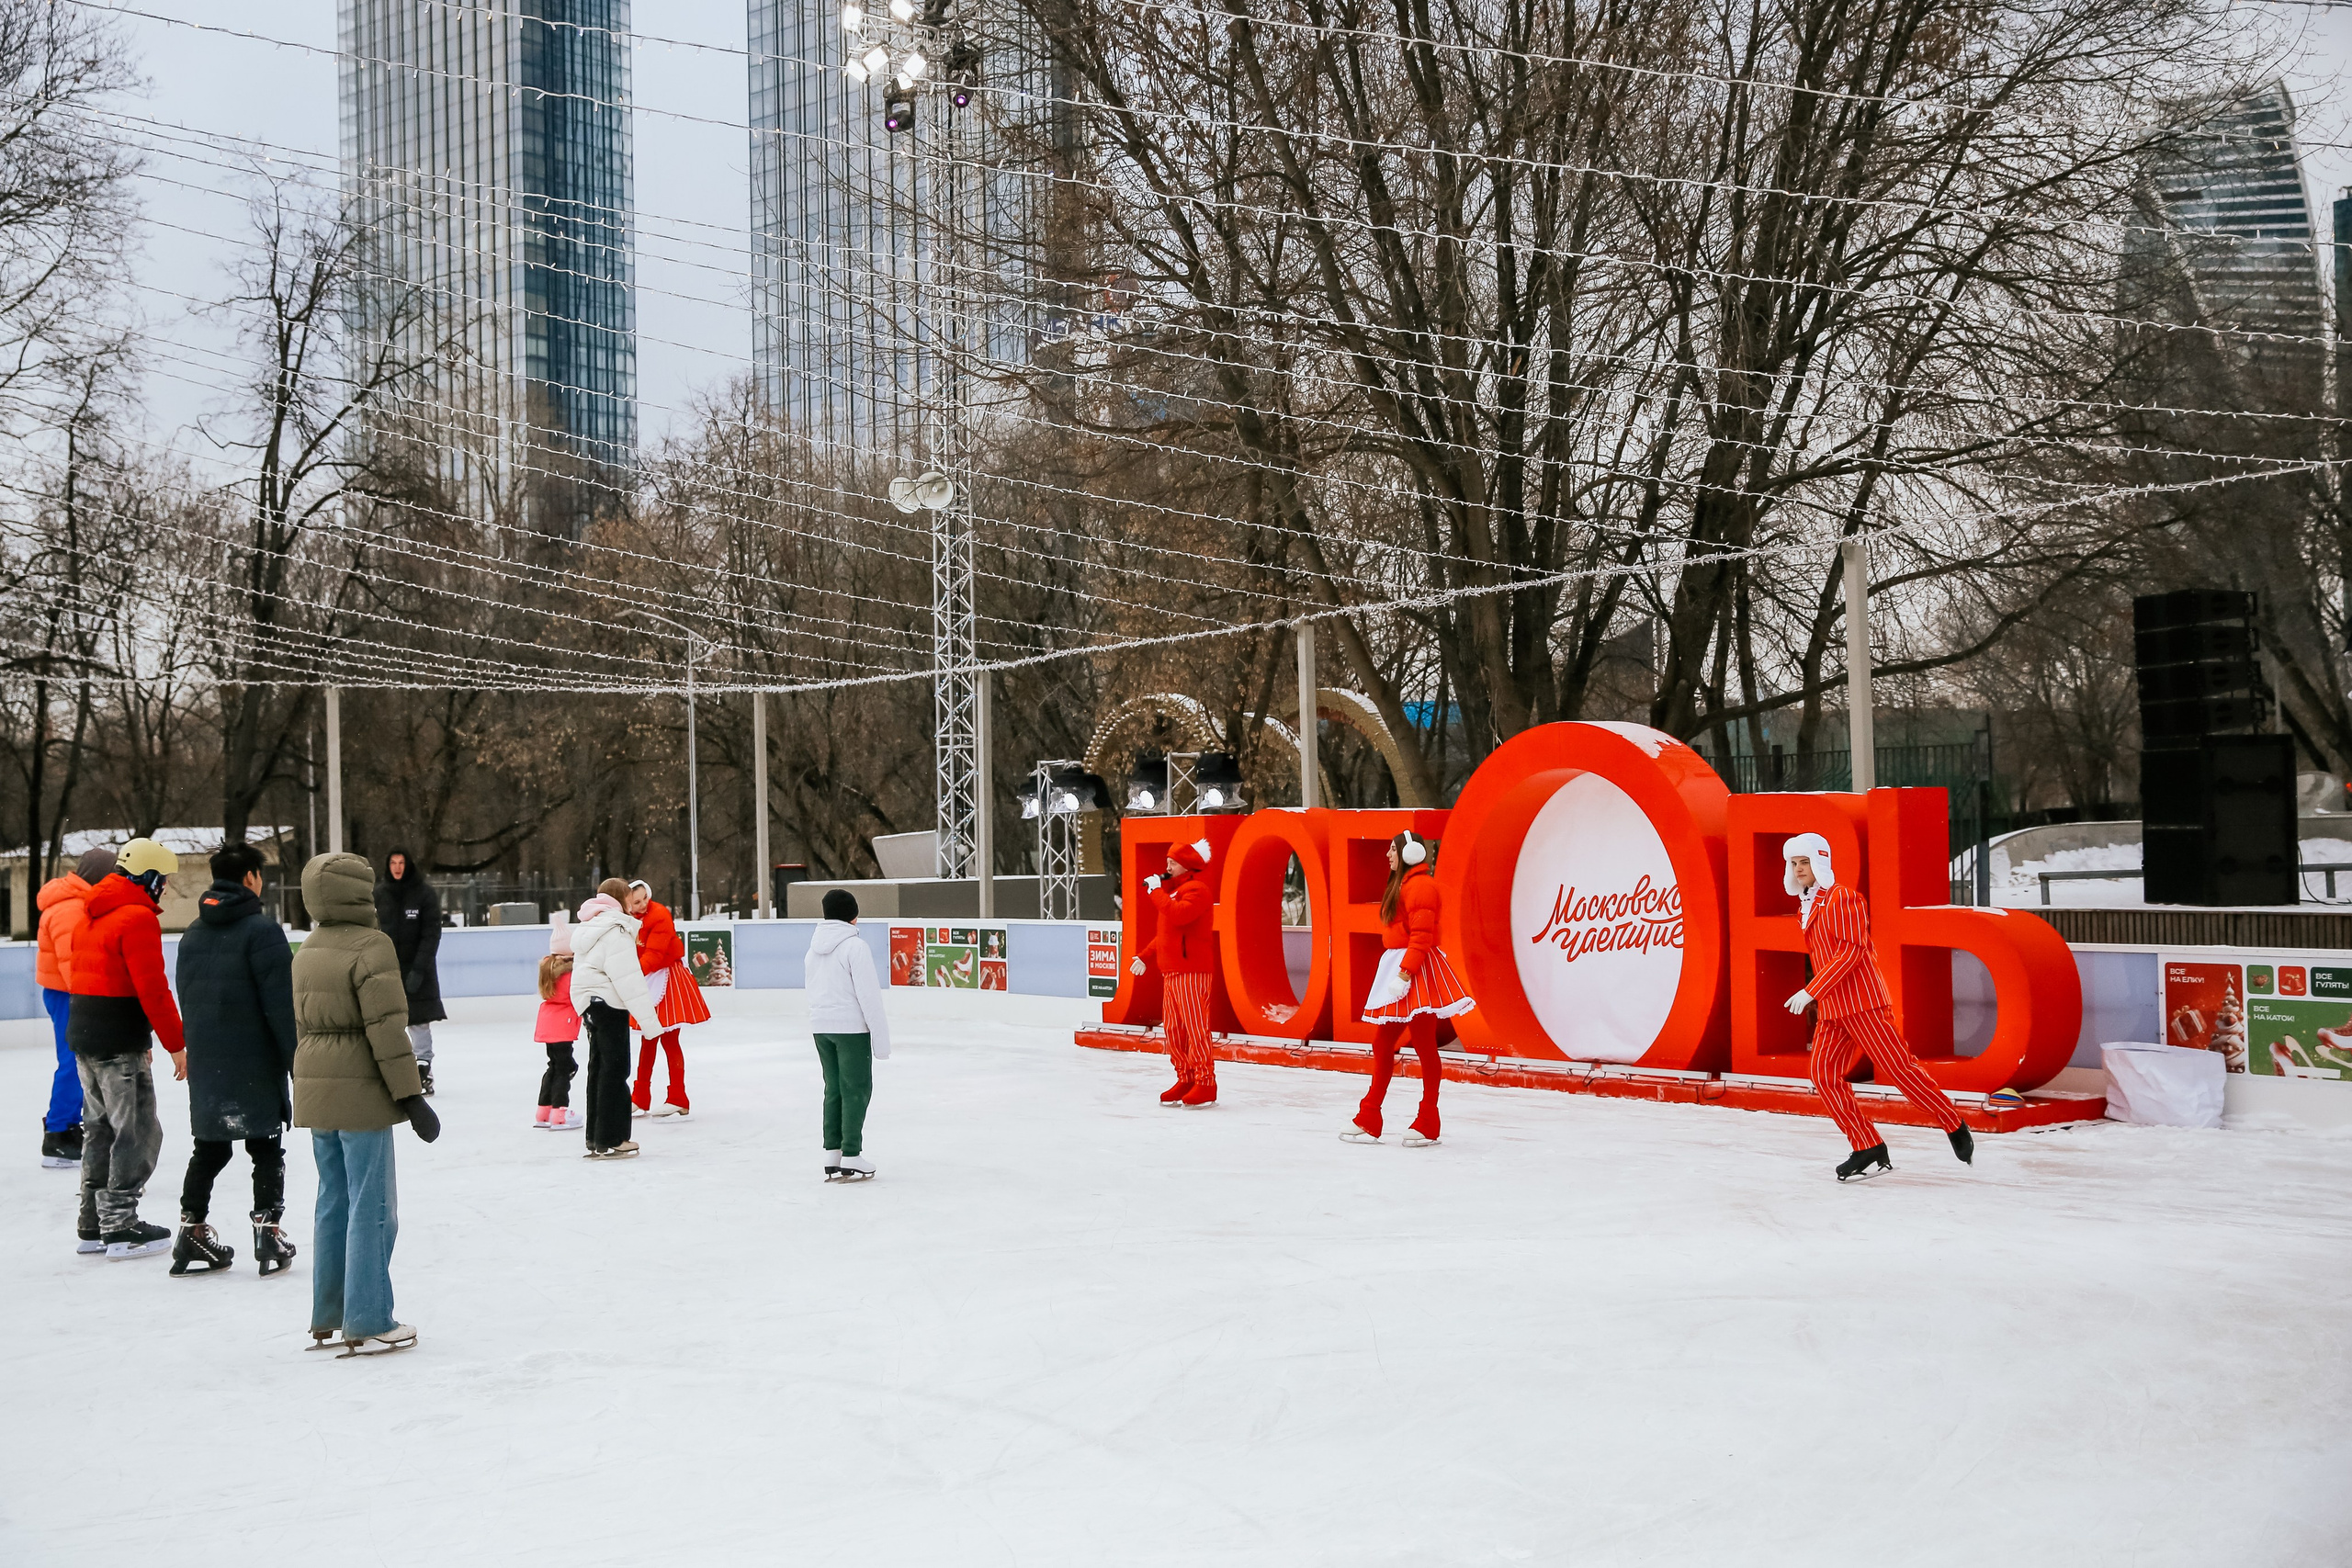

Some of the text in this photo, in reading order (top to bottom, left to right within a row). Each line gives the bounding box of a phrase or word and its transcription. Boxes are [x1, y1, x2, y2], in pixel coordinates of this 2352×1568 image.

[1532, 874, 1683, 944] Московско
[1090, 950, 1115, 962] ЗИМА
[2315, 981, 2350, 989] ГУЛЯТЬ!
